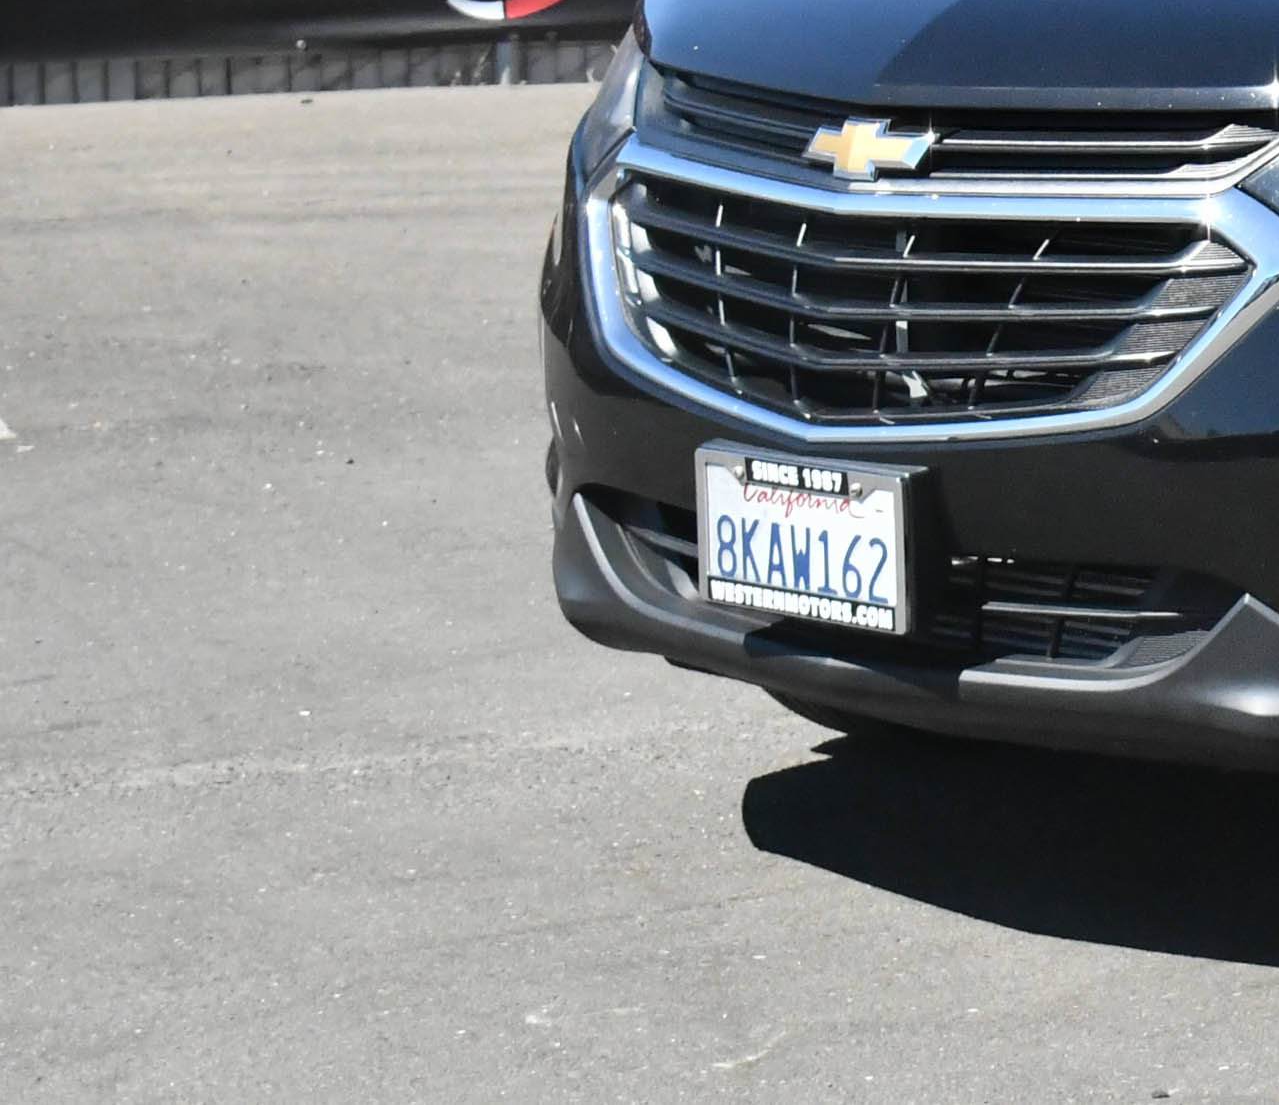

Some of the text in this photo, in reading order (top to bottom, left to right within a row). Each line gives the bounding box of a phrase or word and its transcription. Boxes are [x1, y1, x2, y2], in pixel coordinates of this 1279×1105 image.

[752, 460, 799, 486] SINCE
[716, 514, 889, 604] 8KAW162
[710, 578, 893, 630] WESTERNMOTORS.COM
